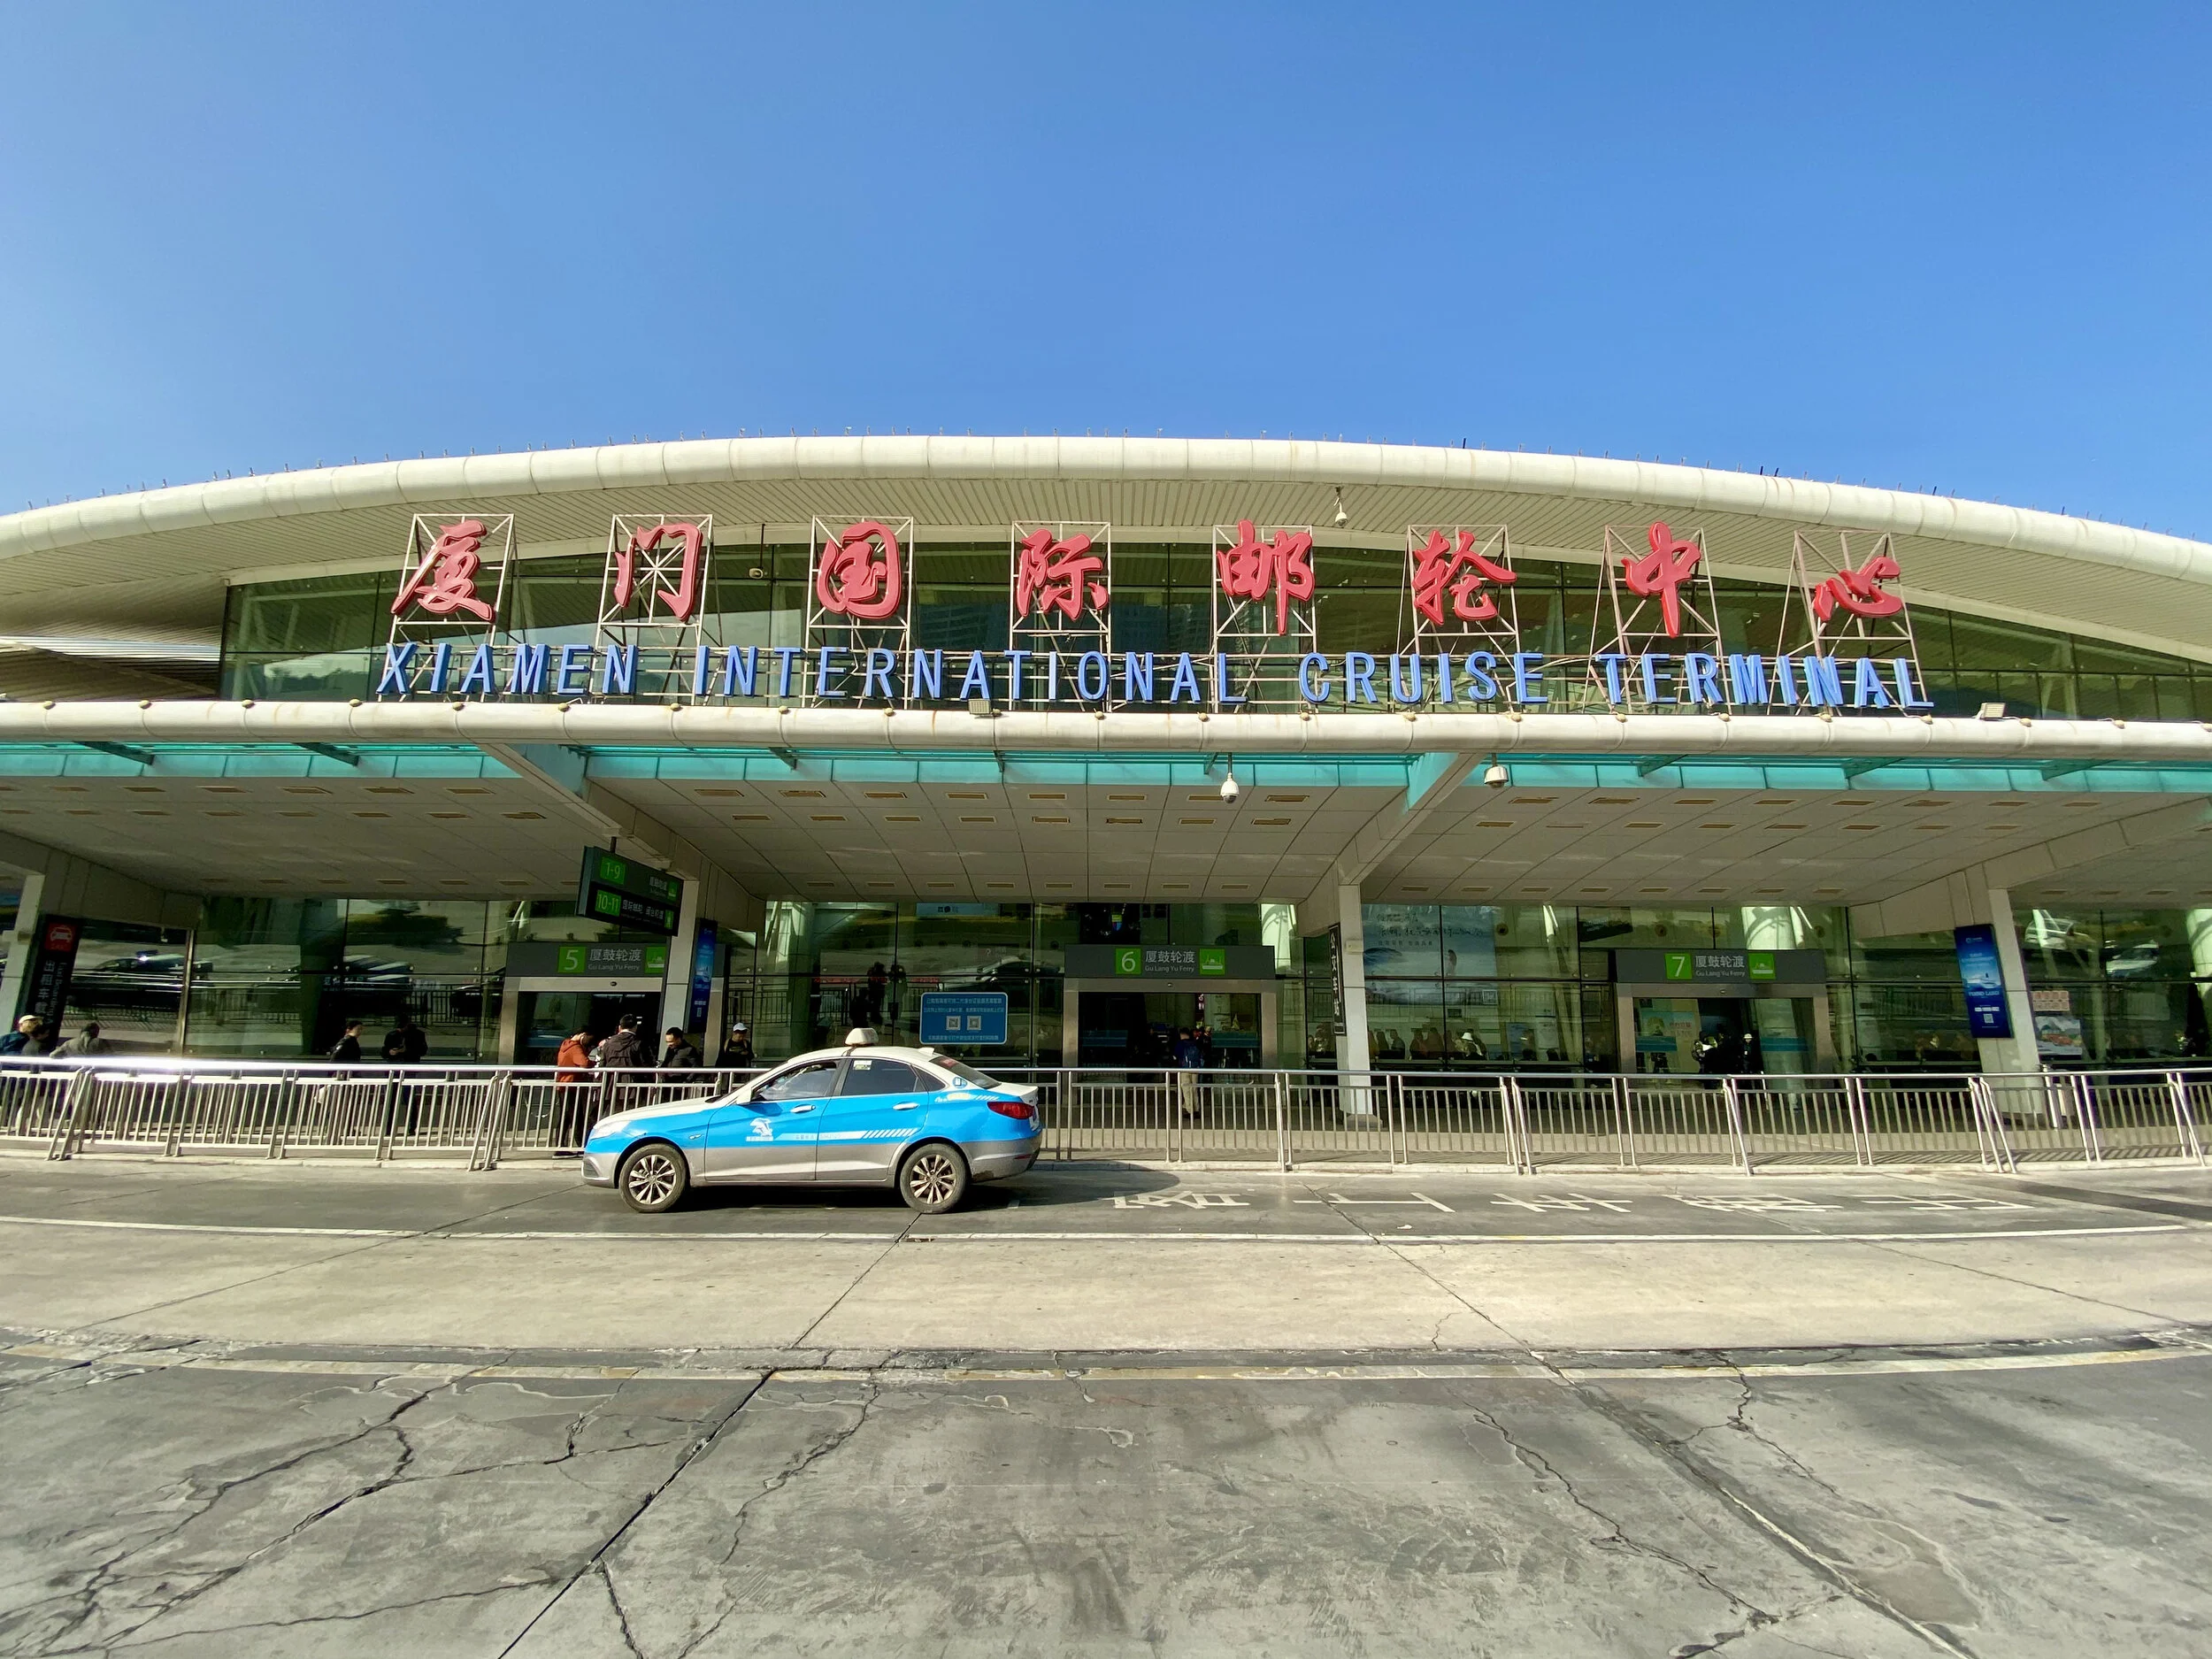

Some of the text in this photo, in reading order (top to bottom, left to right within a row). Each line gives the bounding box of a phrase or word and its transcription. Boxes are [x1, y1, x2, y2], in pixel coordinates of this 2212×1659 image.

[391, 519, 1904, 638] 厦门国际邮轮中心
[376, 642, 1934, 708] XIAMEN INTERNATIONAL CRUISE TERMINAL
[606, 862, 620, 879] 1-9
[598, 894, 618, 911] 10-11
[564, 949, 580, 971] 5
[589, 949, 642, 962] 厦鼓轮渡
[1121, 950, 1136, 972] 6
[1145, 949, 1196, 964] 厦鼓轮渡
[1695, 955, 1746, 968] 厦鼓轮渡
[1155, 964, 1169, 973] Lang
[1179, 964, 1195, 973] Ferry
[1671, 956, 1686, 977] 7
